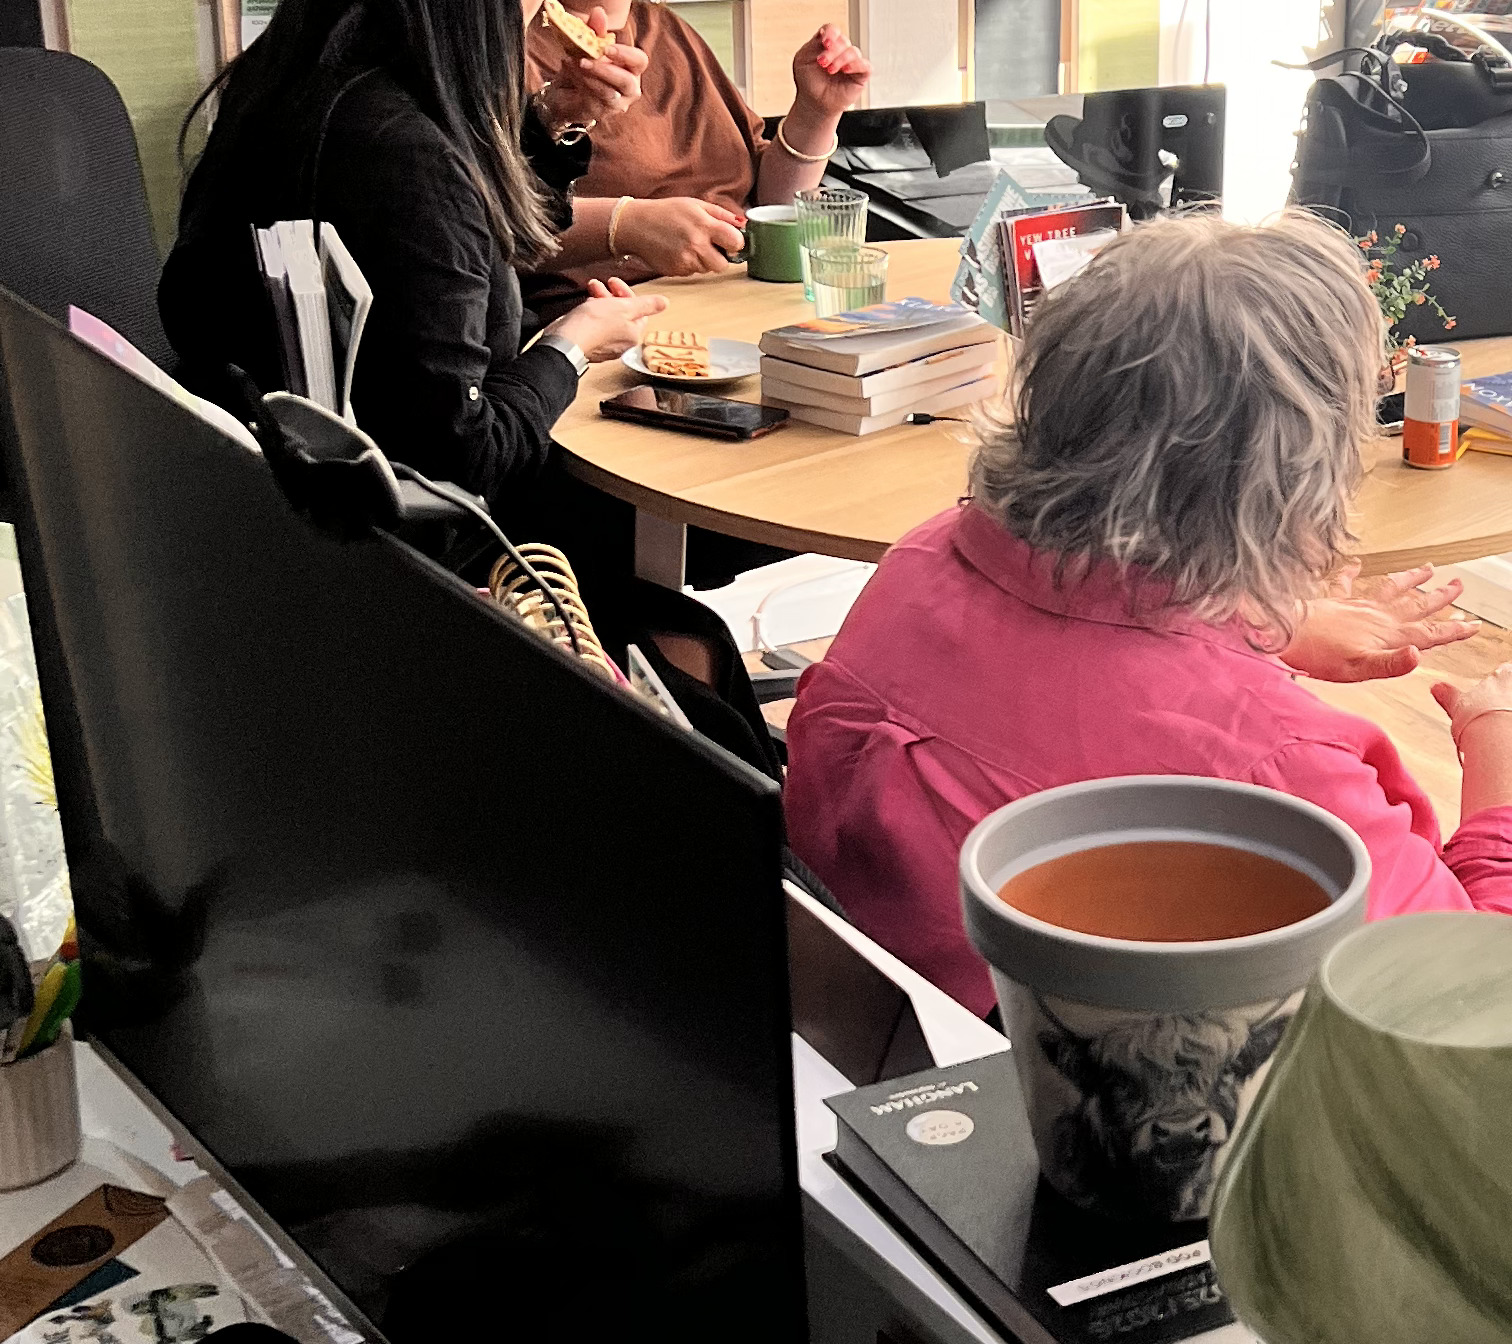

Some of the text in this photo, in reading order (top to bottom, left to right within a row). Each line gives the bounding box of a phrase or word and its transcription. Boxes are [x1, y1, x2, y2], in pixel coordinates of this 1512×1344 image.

[1019, 226, 1077, 247] YEW TREE
[870, 1079, 979, 1118] LANGHAM
